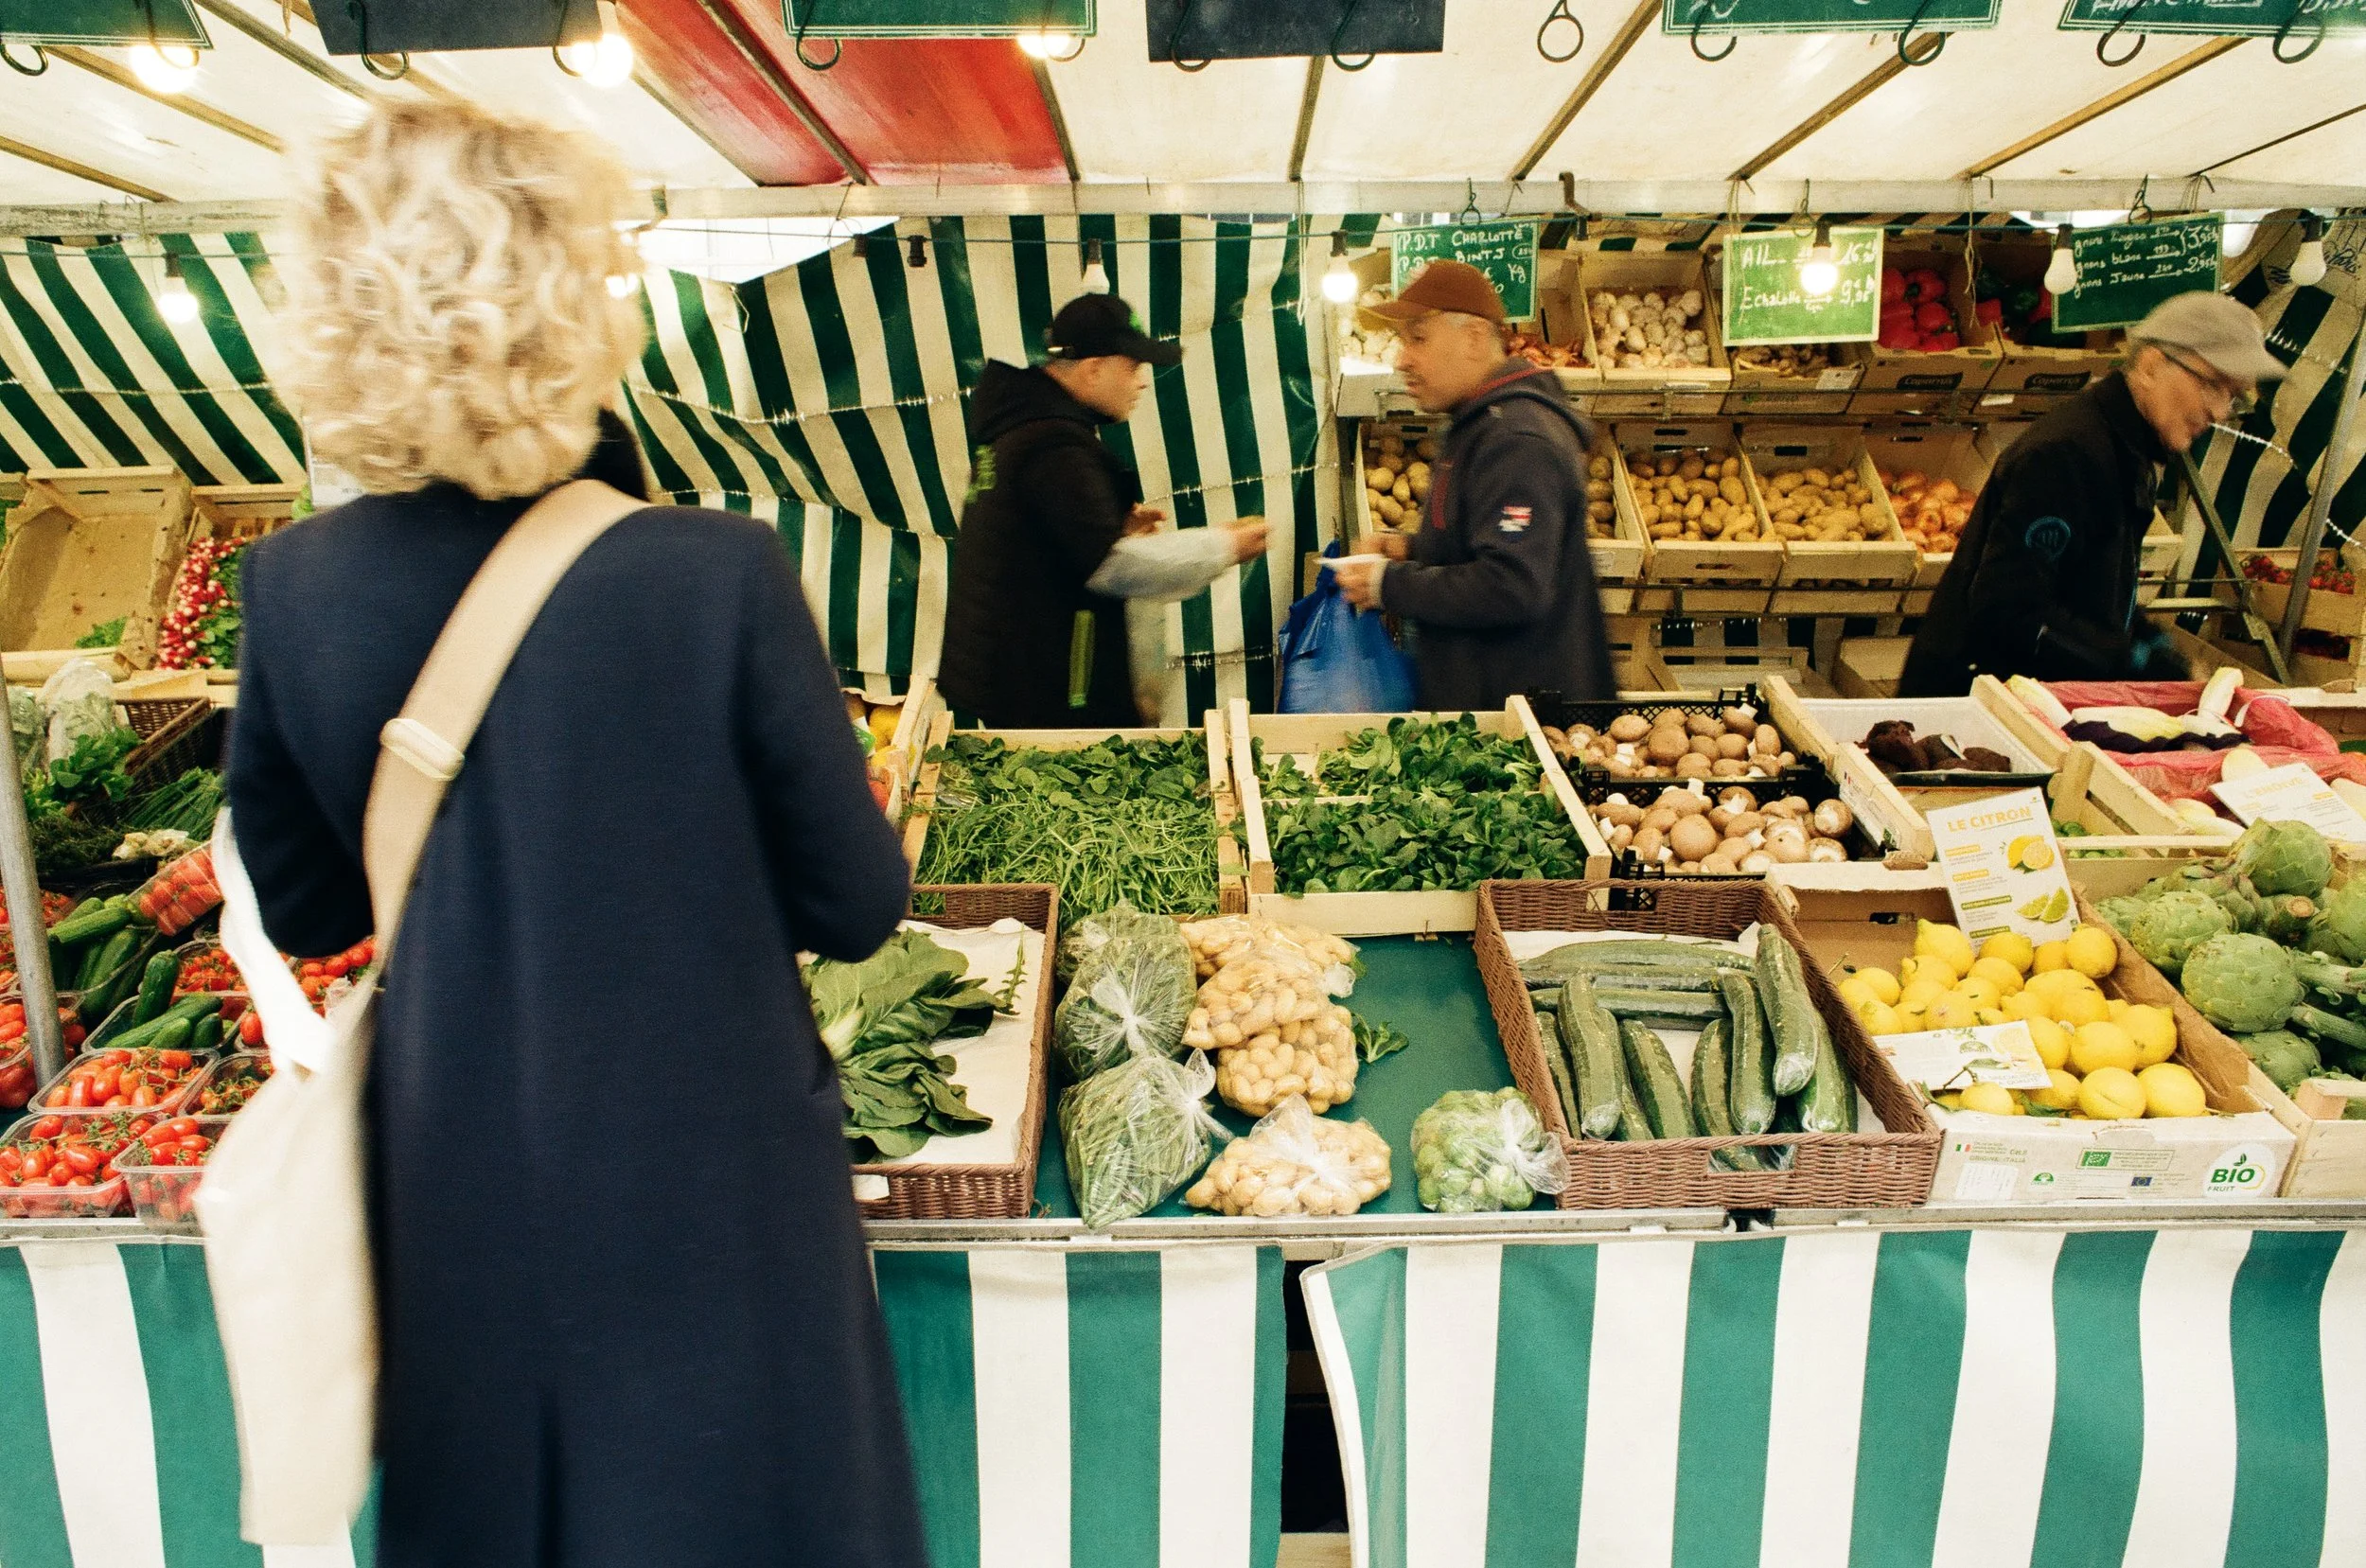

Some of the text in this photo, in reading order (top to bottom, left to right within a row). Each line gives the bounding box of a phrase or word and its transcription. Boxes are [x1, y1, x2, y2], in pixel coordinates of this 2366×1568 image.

[1947, 806, 2033, 833] LE CITRON
[2210, 1168, 2256, 1184] BIO
